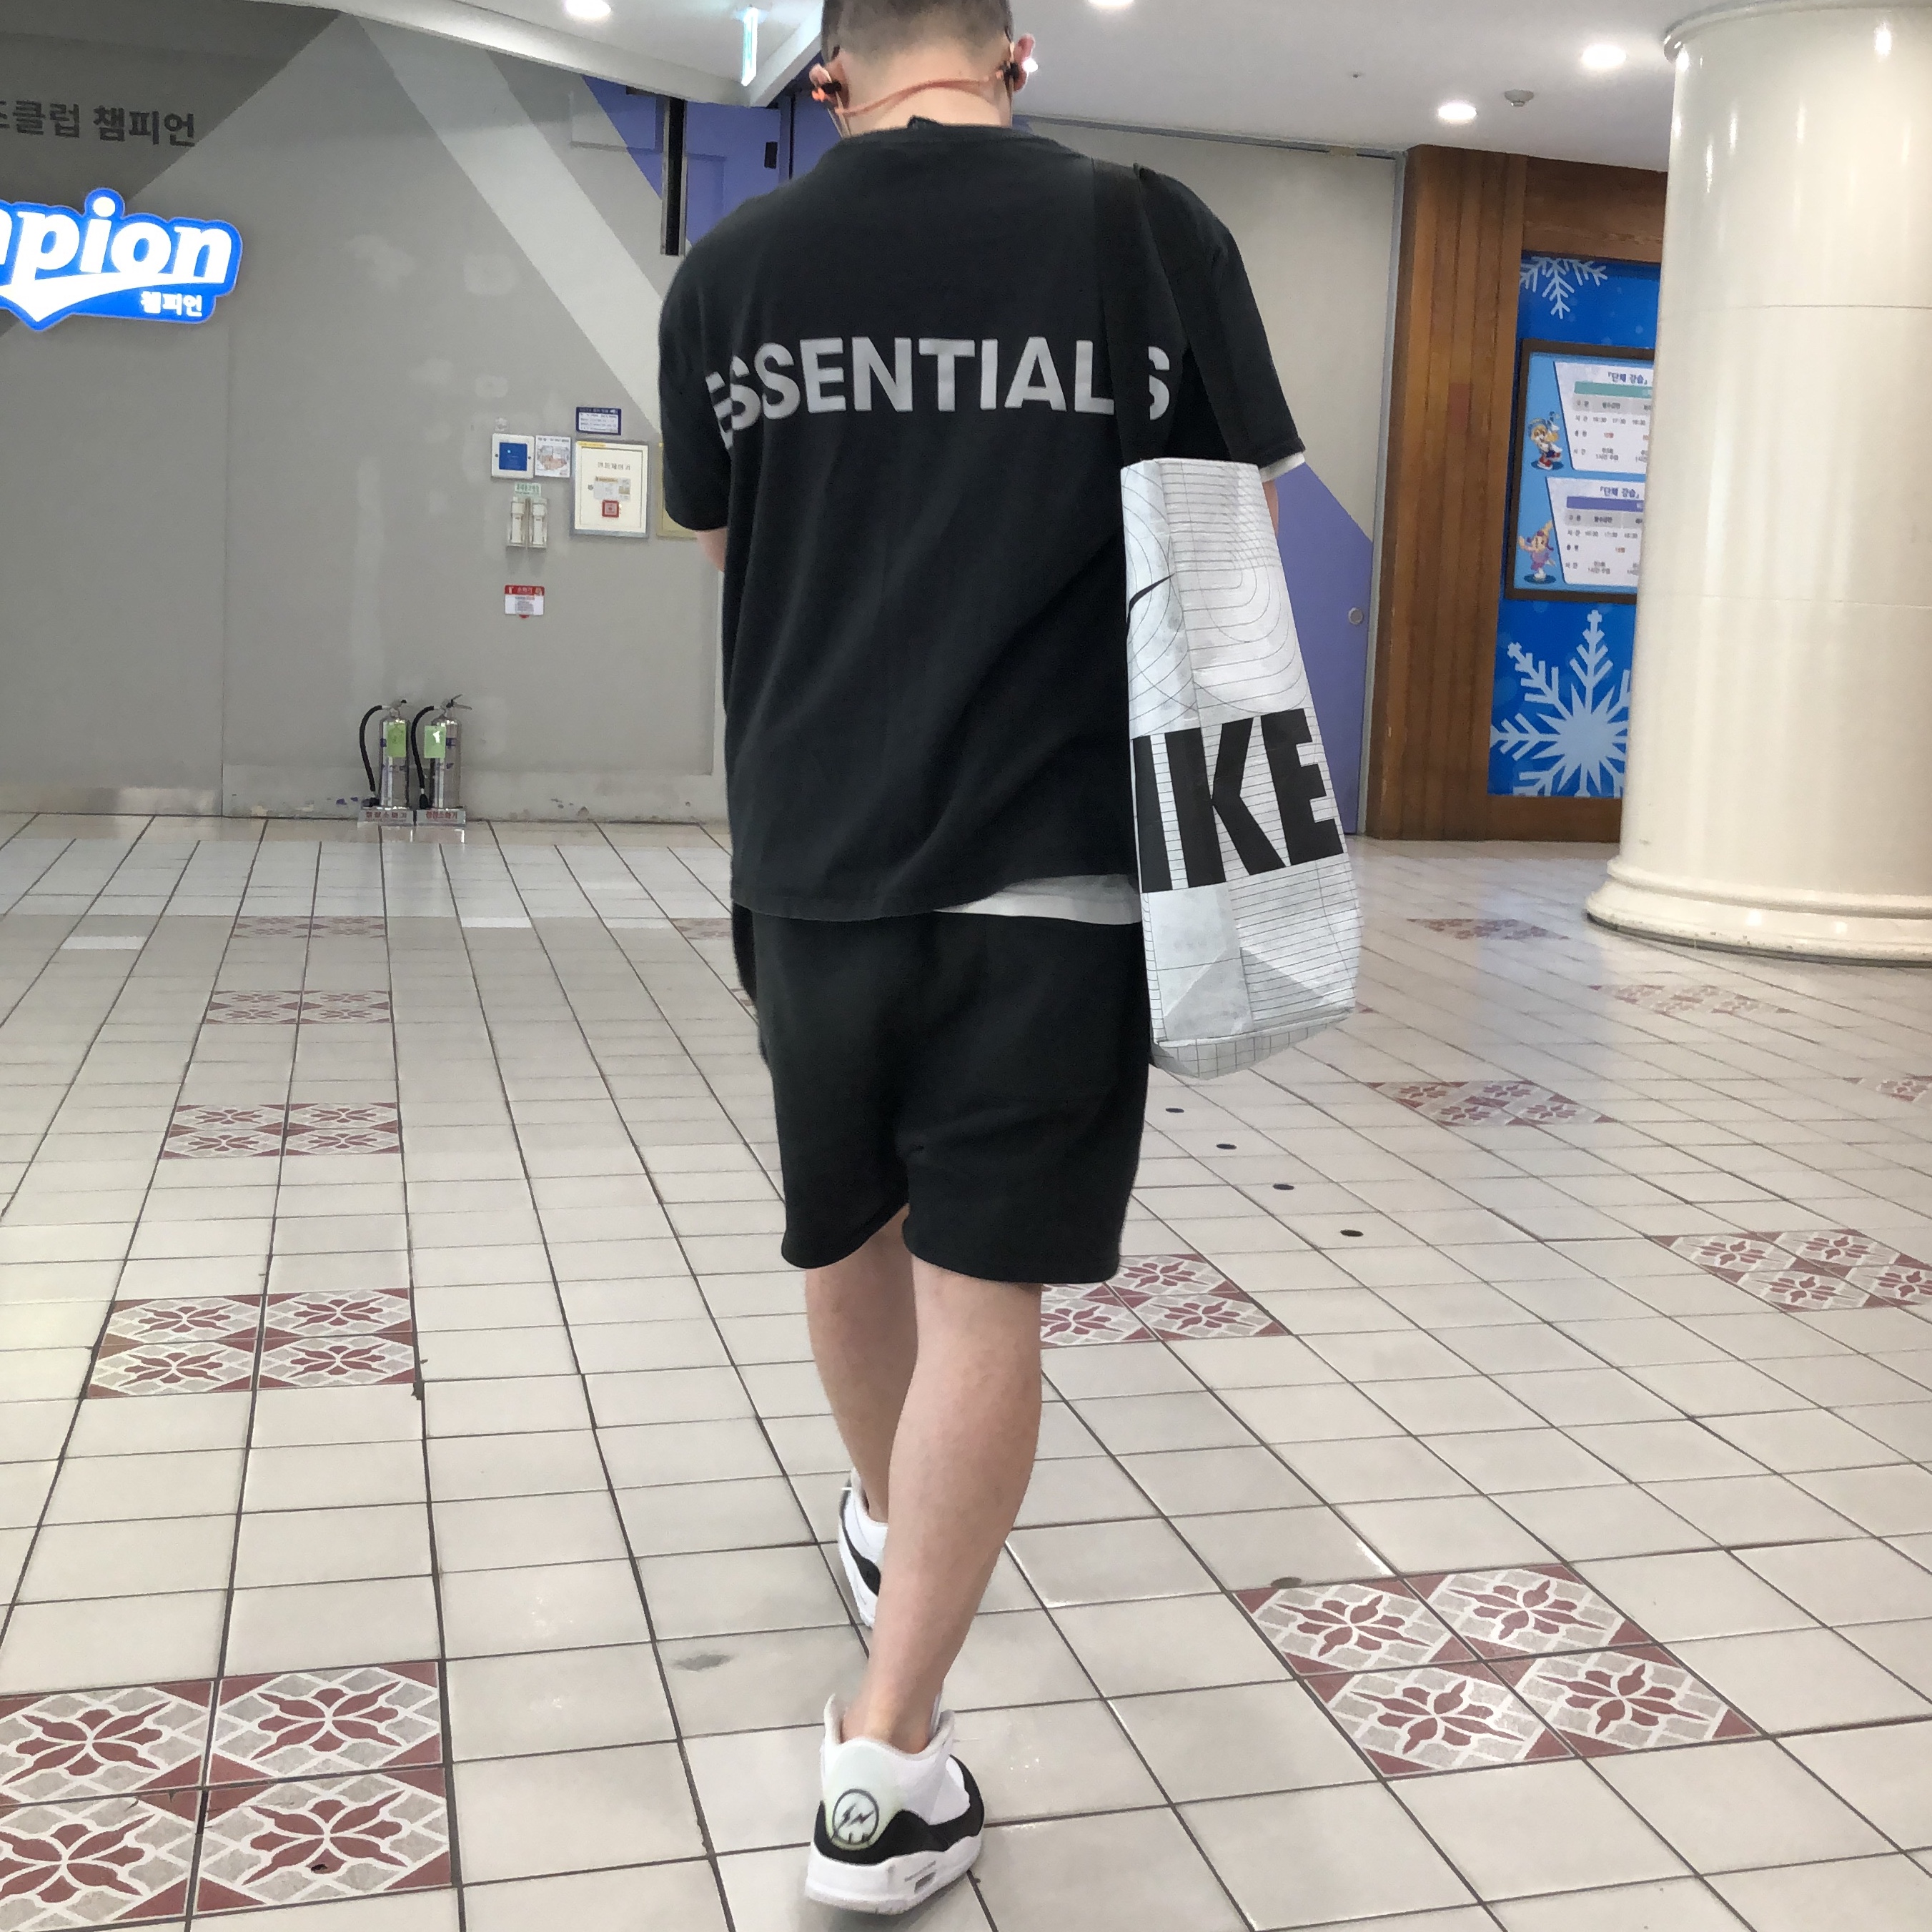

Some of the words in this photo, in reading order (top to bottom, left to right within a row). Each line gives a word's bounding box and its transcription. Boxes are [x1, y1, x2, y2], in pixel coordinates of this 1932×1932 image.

[93, 105, 195, 147] 챔피언
[0, 197, 232, 286] pion
[141, 291, 202, 317] 챔피언
